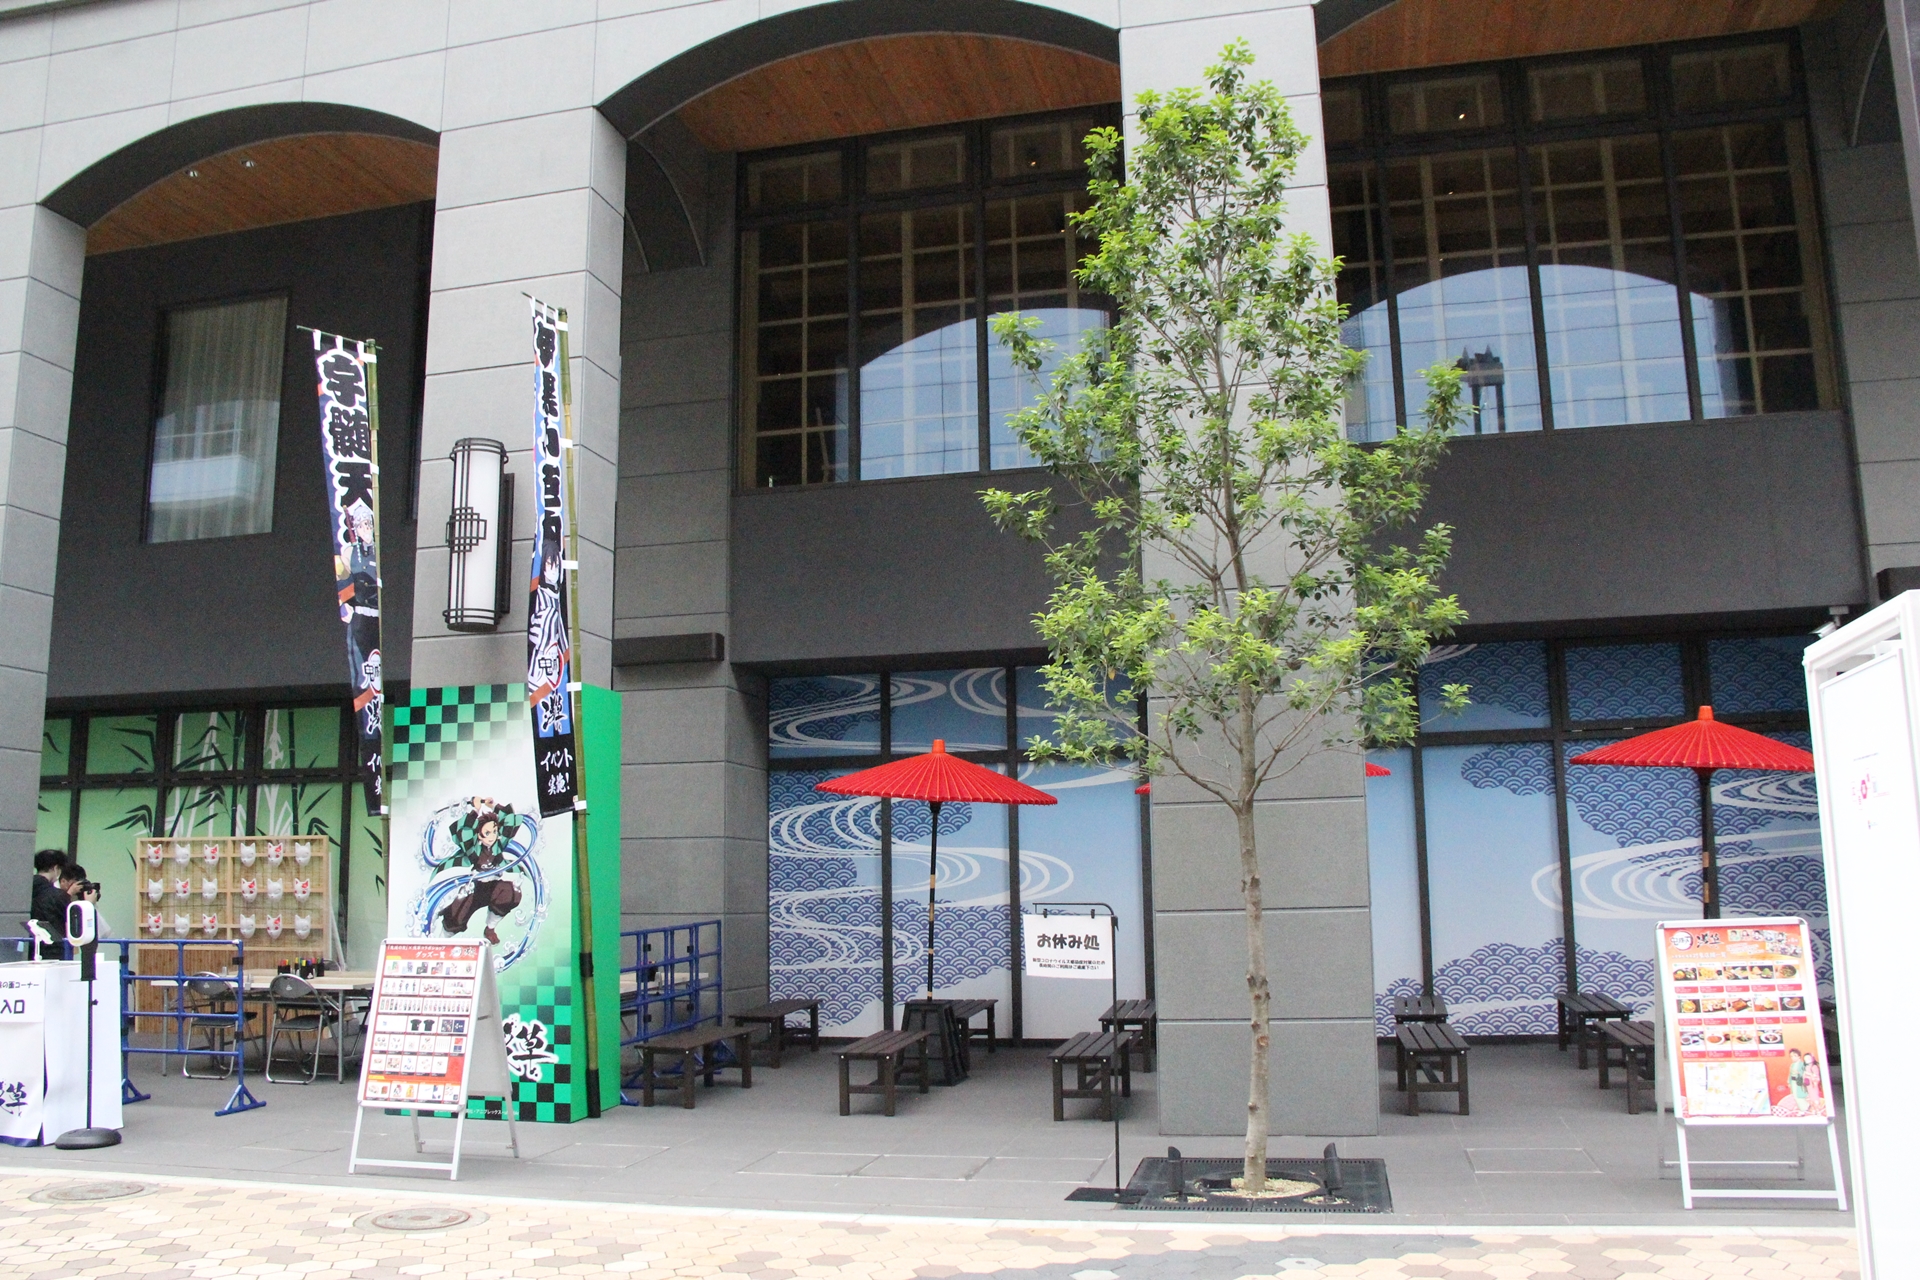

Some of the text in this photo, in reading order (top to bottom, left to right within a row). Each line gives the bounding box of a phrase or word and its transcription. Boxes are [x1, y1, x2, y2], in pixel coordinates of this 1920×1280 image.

[540, 747, 573, 772] イベント
[1037, 934, 1099, 950] お休み処
